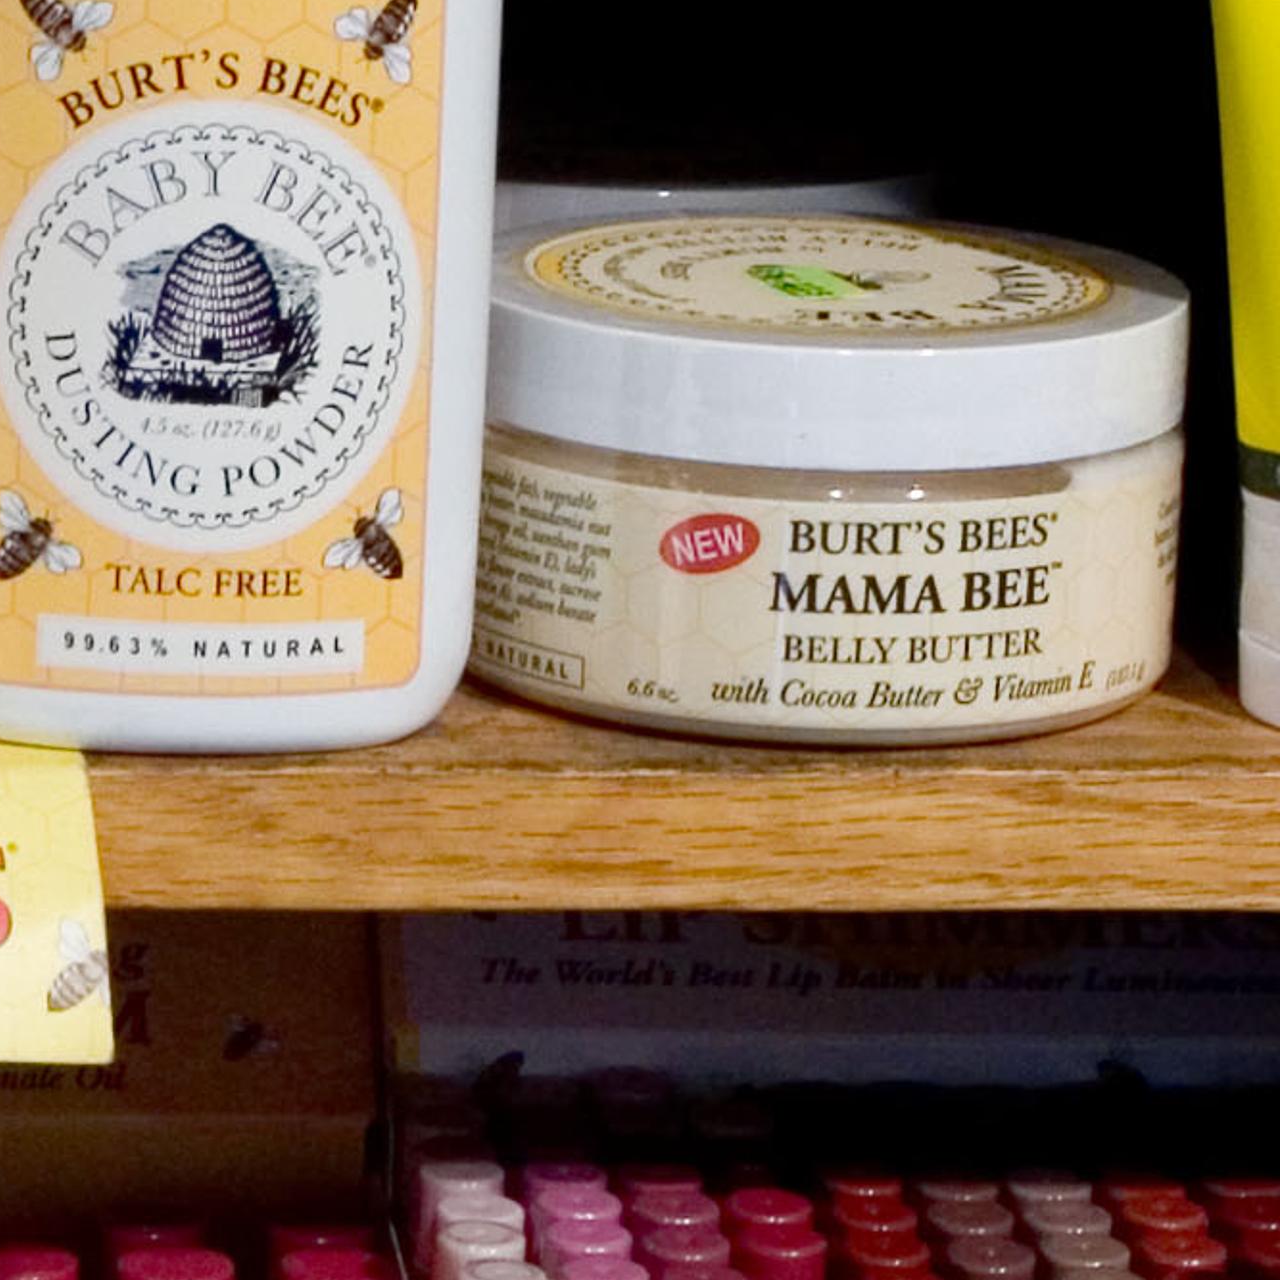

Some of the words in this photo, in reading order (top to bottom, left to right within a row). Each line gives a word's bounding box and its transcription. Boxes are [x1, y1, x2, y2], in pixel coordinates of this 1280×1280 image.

[57, 48, 241, 129] BURT'S
[260, 59, 373, 128] BEES
[60, 149, 236, 268] BABY
[254, 159, 368, 278] BEE
[45, 330, 200, 496] DUSTING
[221, 339, 374, 497] POWDER
[670, 525, 745, 564] NEW
[789, 521, 947, 554] BURT'S
[958, 516, 1048, 549] BEES
[105, 565, 202, 597] TALC
[214, 568, 303, 597] FREE
[769, 574, 944, 615] MAMA
[962, 569, 1051, 611] BEE
[64, 633, 168, 657] 99.63%
[193, 636, 346, 657] NATURAL
[782, 634, 899, 663] BELLY
[906, 628, 1043, 660] BUTTER
[711, 679, 769, 707] with
[780, 681, 858, 708] Cocoa
[867, 678, 942, 708] Butter
[953, 676, 982, 705] &
[992, 673, 1072, 704] Vitamin
[1077, 661, 1094, 690] E
